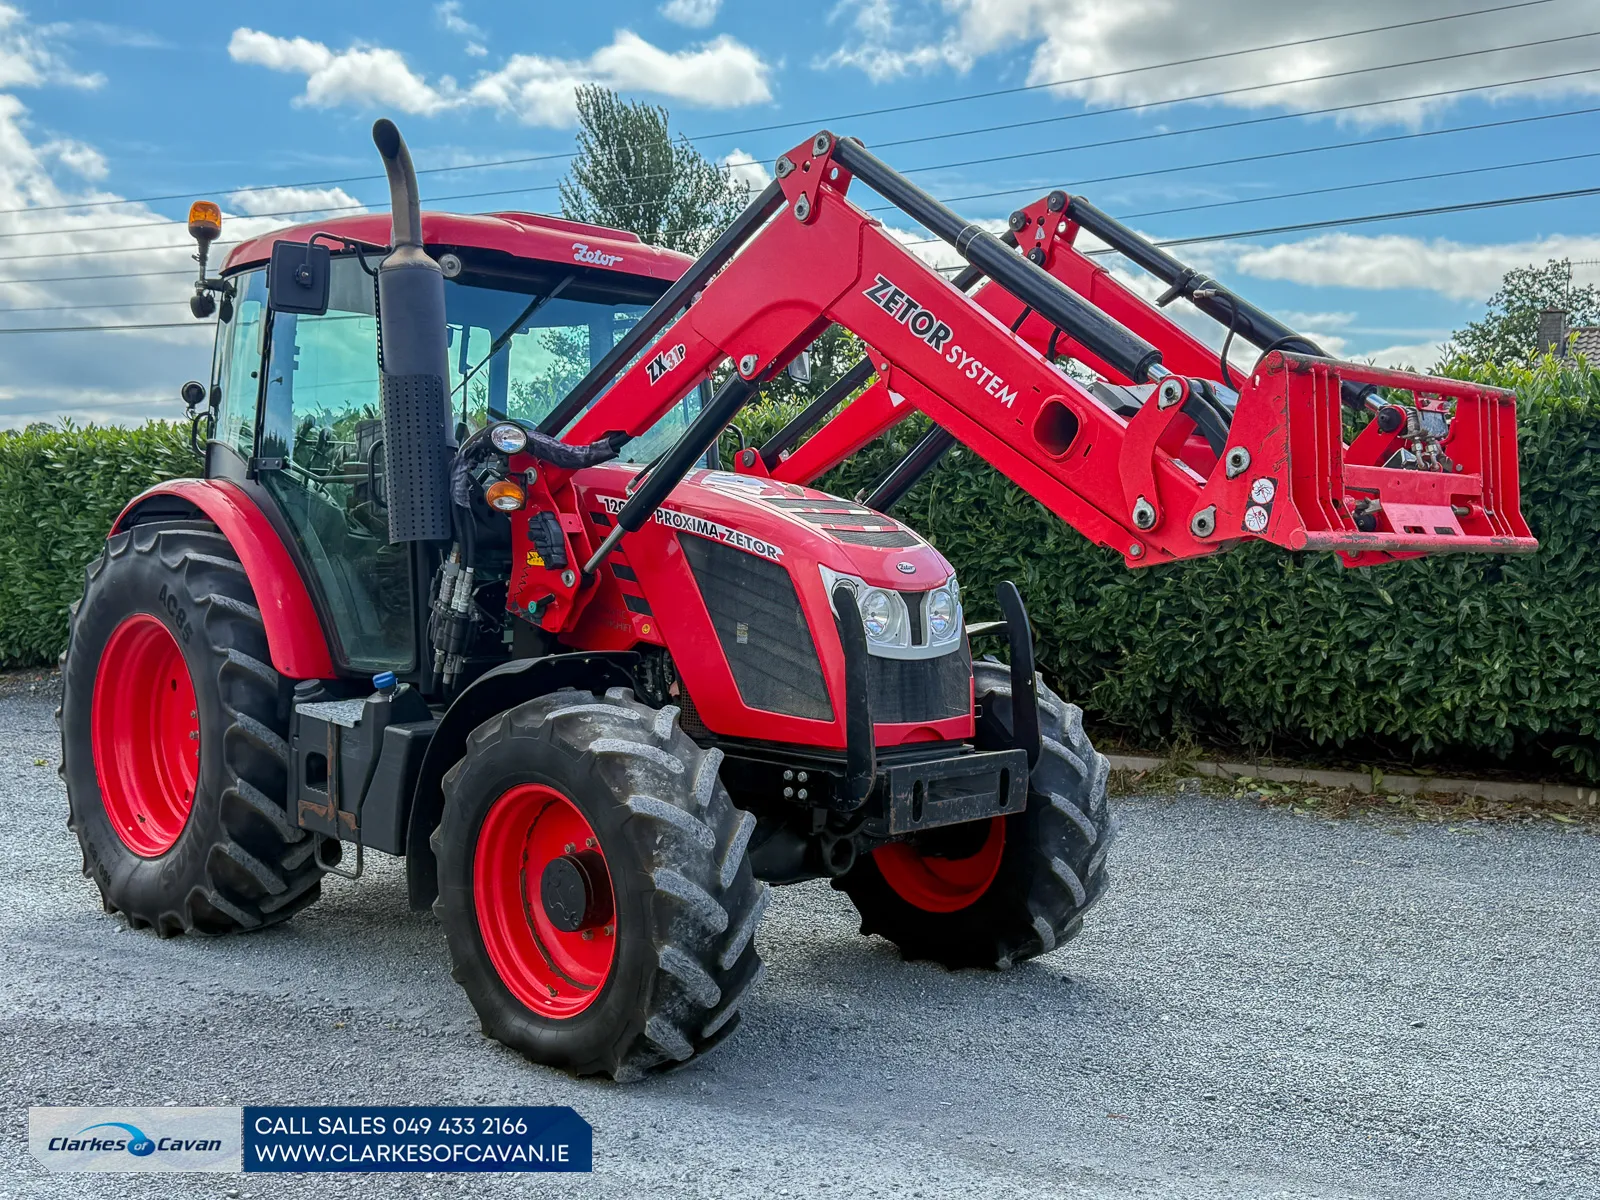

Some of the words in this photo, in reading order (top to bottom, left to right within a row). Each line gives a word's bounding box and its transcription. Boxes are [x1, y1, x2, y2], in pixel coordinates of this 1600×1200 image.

[571, 242, 624, 267] Zetor
[863, 274, 952, 352] ZETOR
[945, 345, 1019, 409] SYSTEM
[656, 509, 719, 538] PROXIMA
[724, 529, 778, 559] ZETOR
[159, 583, 194, 644] AC85
